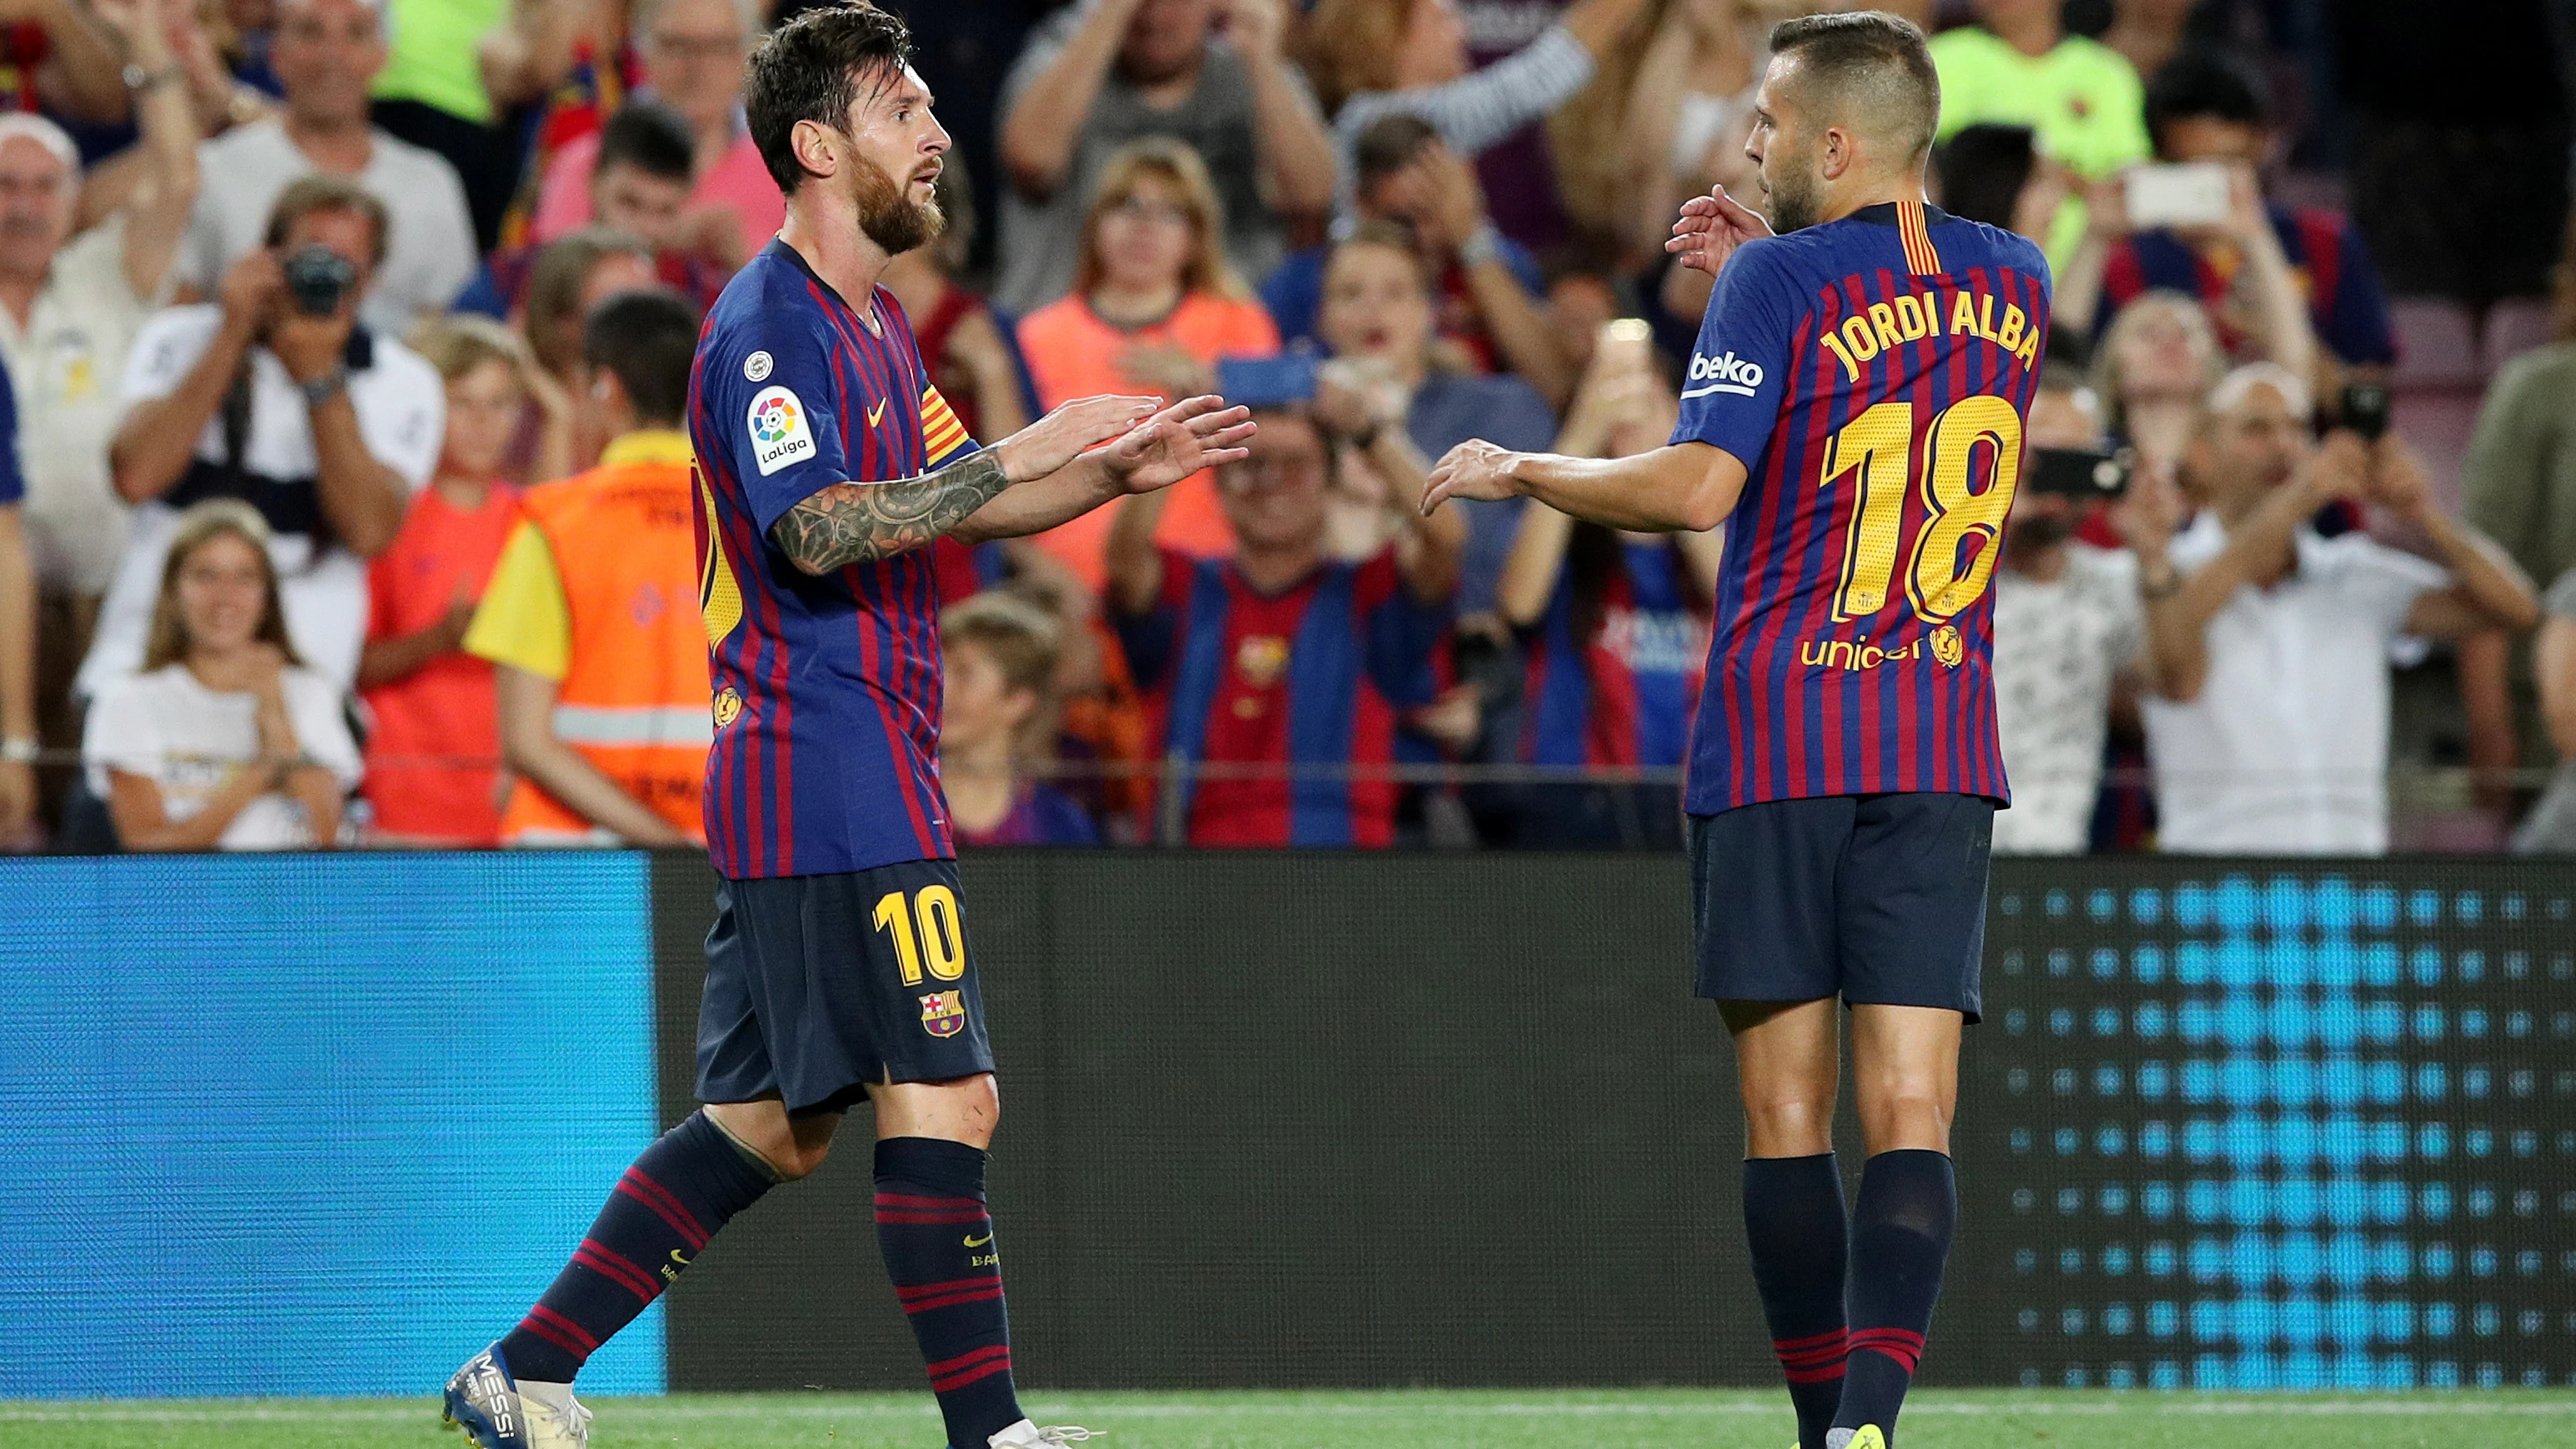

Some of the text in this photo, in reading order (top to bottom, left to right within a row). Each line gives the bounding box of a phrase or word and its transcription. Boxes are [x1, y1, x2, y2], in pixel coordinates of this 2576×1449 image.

[1690, 351, 1764, 387] beko
[1820, 291, 2039, 383] JORDI ALBA
[761, 439, 807, 463] LaLiga
[1820, 395, 2022, 624] 18
[871, 884, 966, 987] 10
